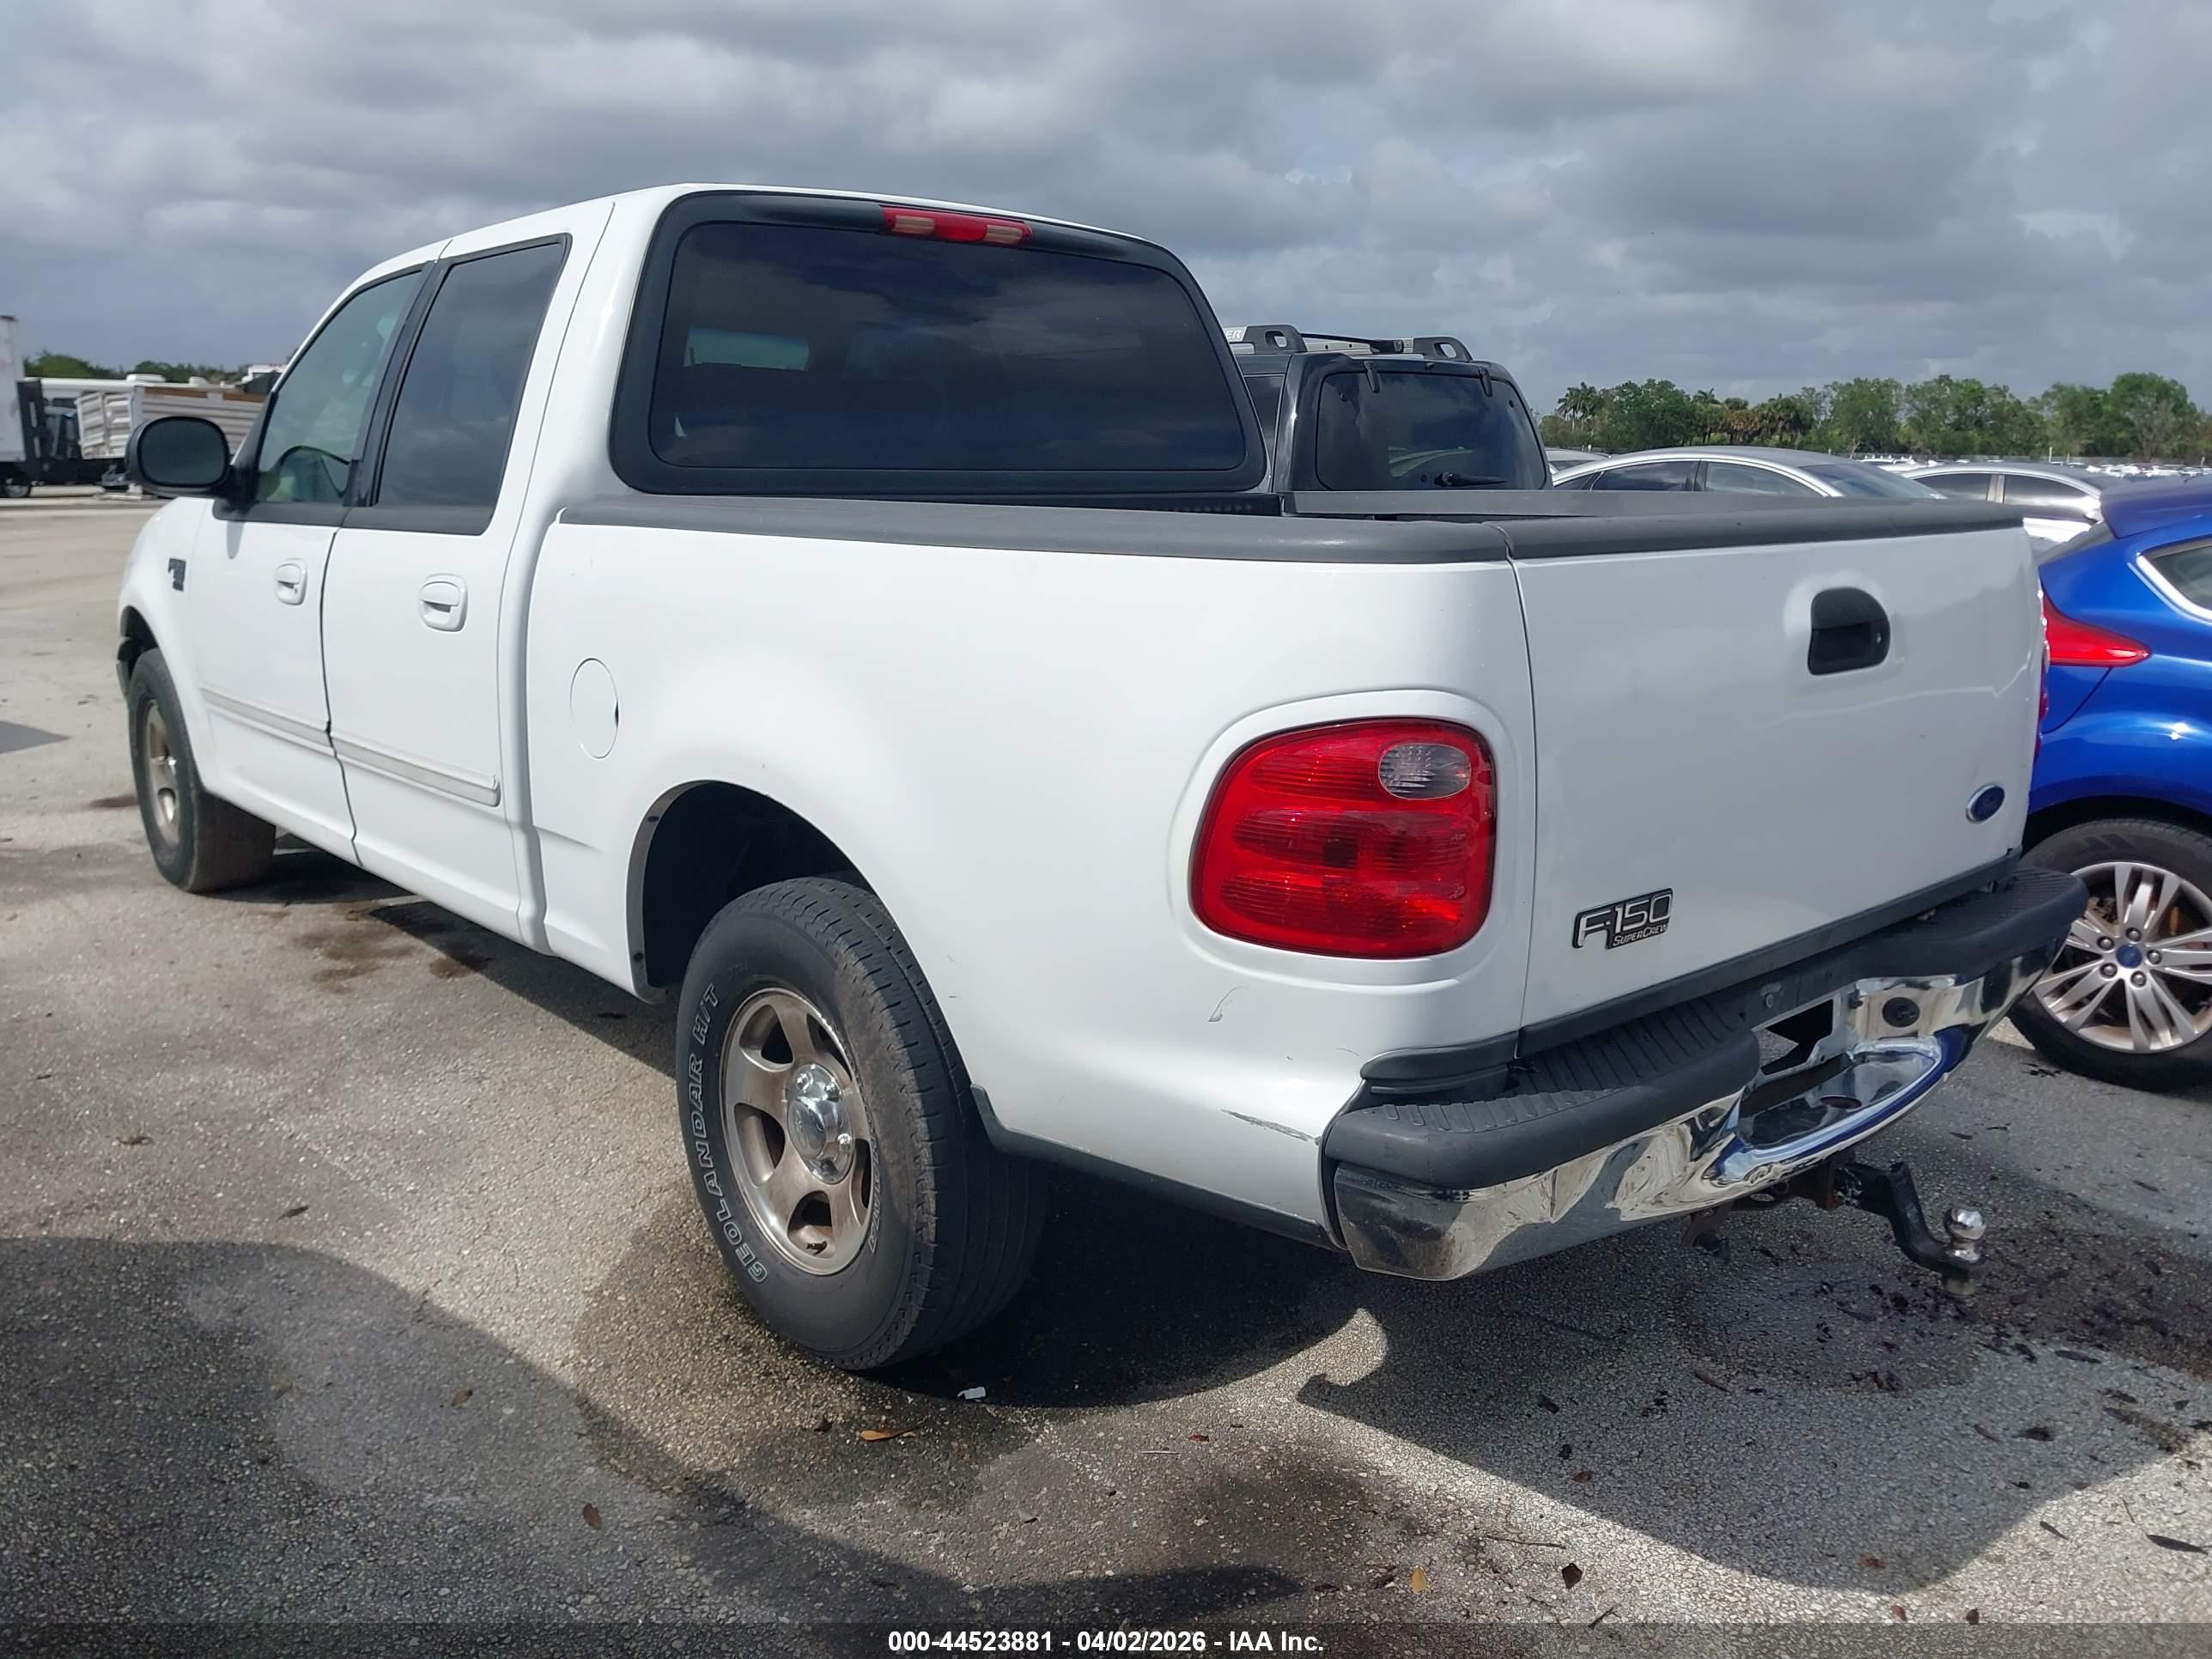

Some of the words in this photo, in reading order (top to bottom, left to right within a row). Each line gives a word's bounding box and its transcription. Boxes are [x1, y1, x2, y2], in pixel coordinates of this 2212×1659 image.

[1577, 893, 1672, 947] F-150
[692, 983, 720, 1045] H/T
[689, 1053, 768, 1284] GEOLANDAR
